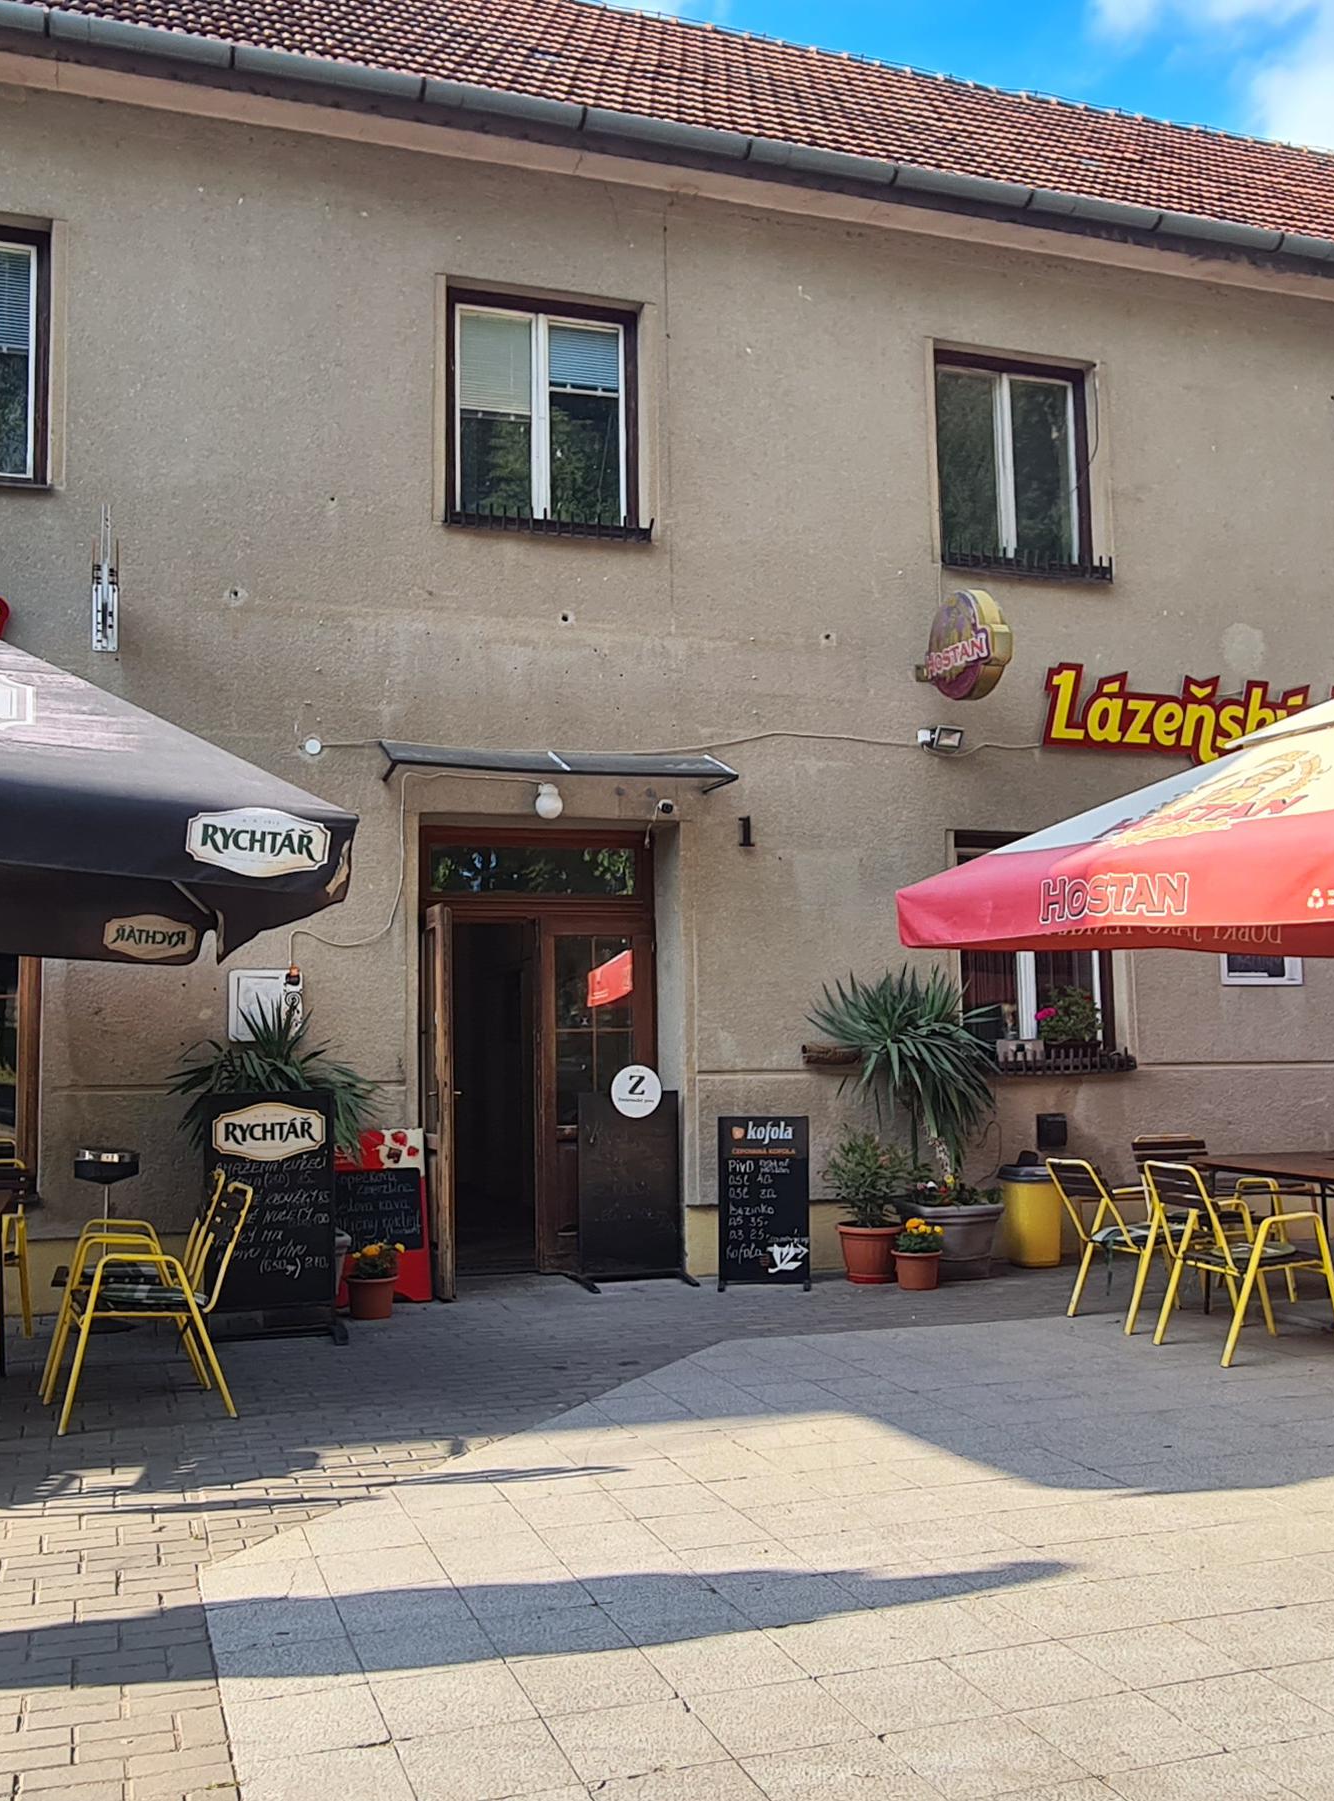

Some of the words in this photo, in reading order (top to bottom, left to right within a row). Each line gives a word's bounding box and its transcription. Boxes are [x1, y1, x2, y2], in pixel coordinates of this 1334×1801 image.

[924, 631, 989, 680] HOSTAN
[200, 822, 318, 866] RYCHTÁŘ
[1039, 872, 1189, 925] HOSTAN
[628, 1075, 646, 1096] Z
[223, 1116, 318, 1146] RYCHTÁŘ
[747, 1120, 794, 1145] kofola
